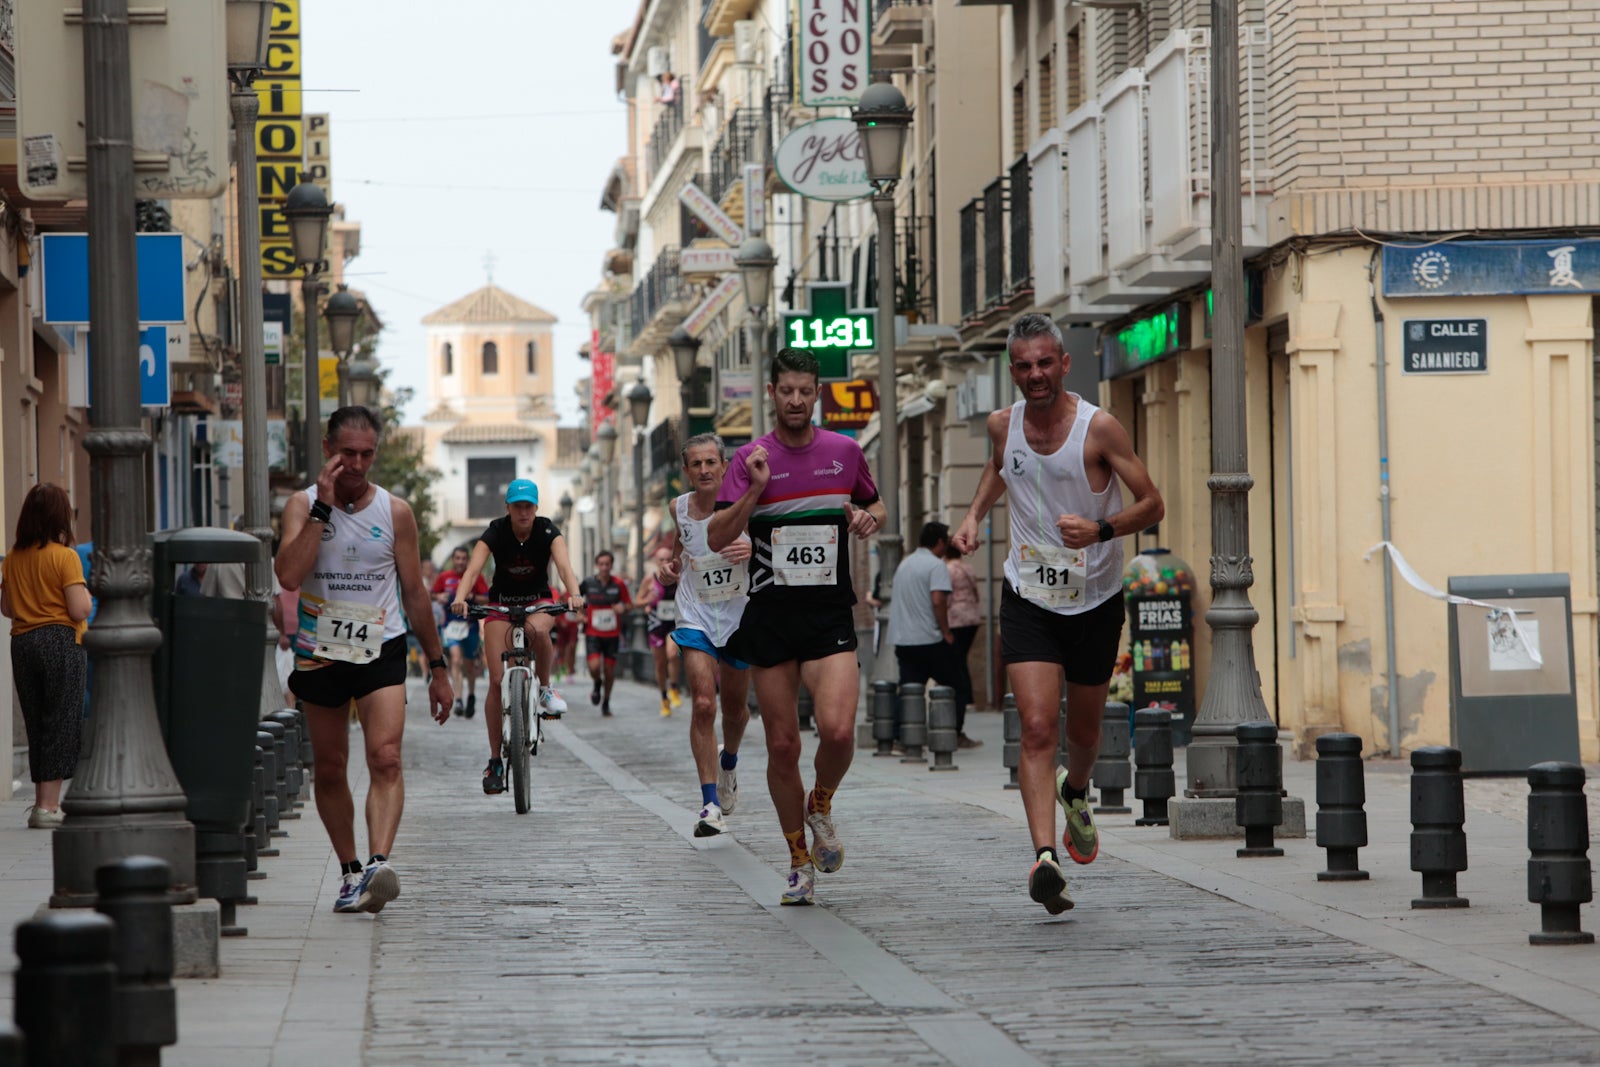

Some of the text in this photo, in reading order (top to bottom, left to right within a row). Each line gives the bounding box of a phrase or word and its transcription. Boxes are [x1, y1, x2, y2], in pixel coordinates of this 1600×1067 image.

[790, 317, 873, 348] 11:31
[1430, 323, 1479, 336] CALLE
[786, 546, 826, 565] 463
[702, 568, 733, 587] 137
[1036, 565, 1069, 586] 181
[328, 583, 372, 591] MARACENA
[1138, 601, 1182, 611] BEBIDAS
[331, 619, 368, 642] 714
